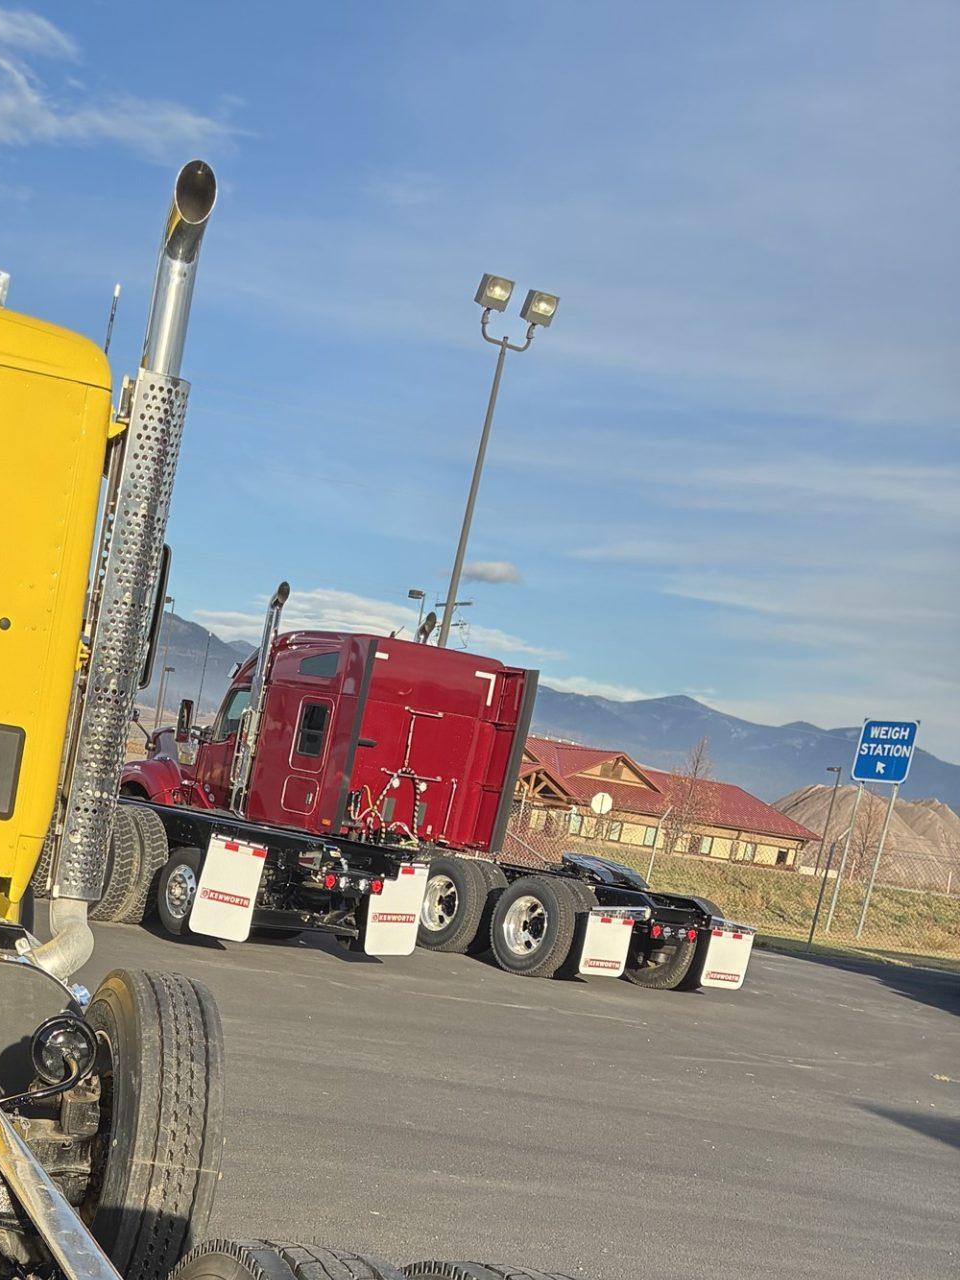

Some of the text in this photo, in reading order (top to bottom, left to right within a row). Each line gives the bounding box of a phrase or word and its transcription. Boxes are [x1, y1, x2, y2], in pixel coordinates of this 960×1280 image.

[870, 726, 910, 740] WEIGH
[860, 743, 912, 758] STATION
[209, 890, 249, 907] KENWORTH
[379, 914, 415, 922] KENWORTH
